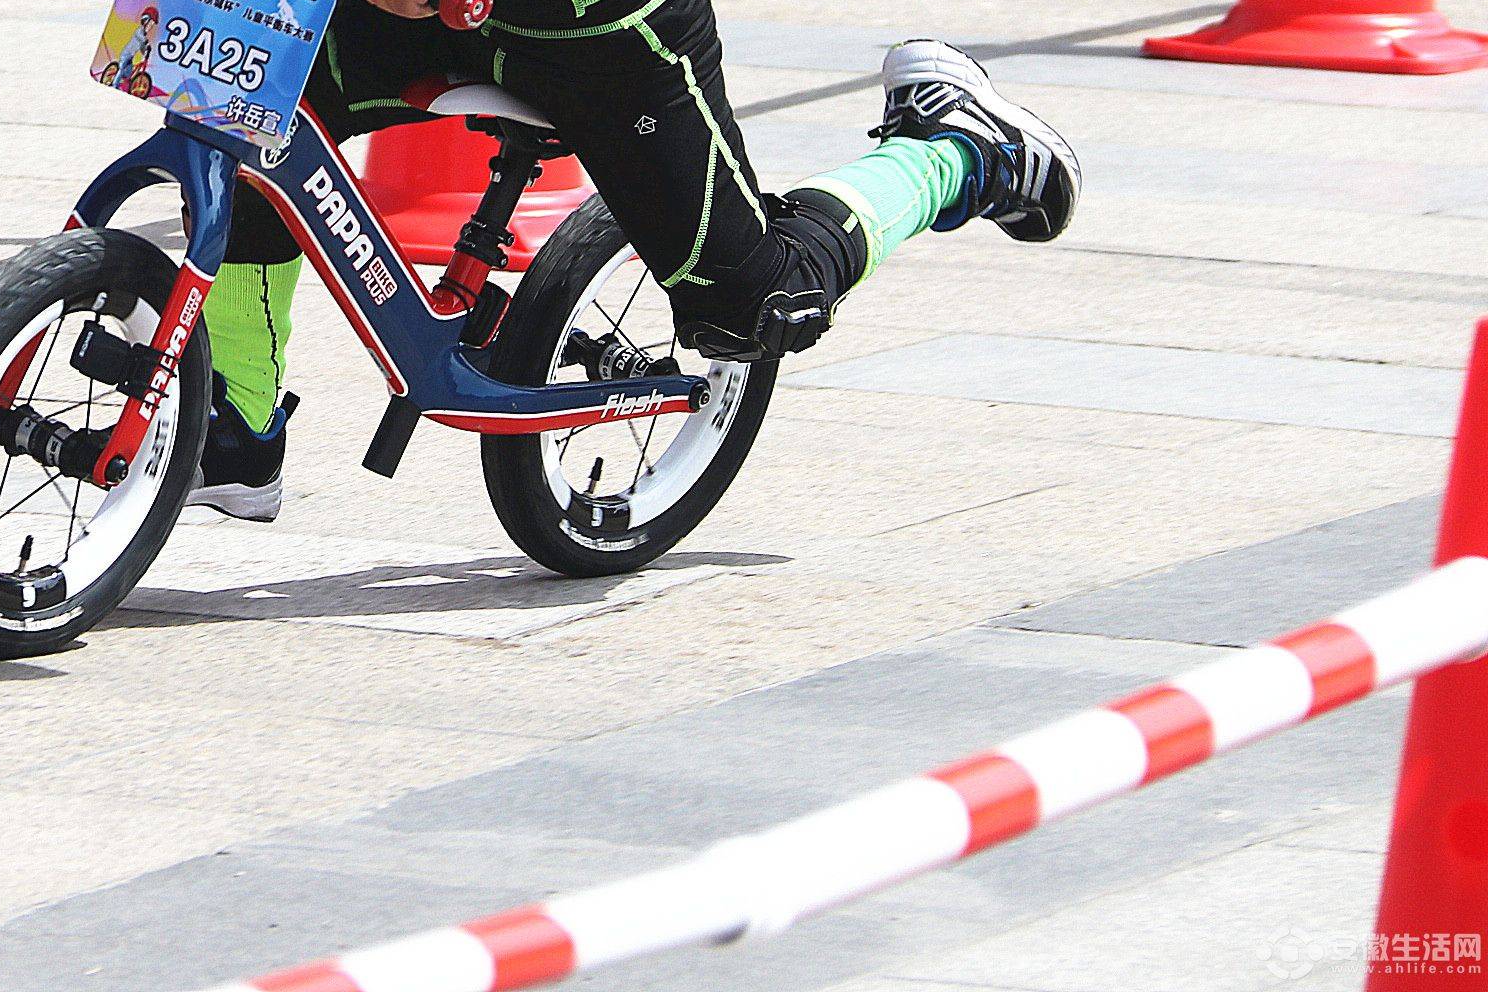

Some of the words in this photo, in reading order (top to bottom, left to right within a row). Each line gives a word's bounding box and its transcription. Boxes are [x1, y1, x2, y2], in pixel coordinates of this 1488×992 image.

[158, 16, 271, 93] 3A25
[303, 165, 375, 271] PAPA
[370, 258, 397, 297] BIKE
[360, 269, 387, 306] PLUS
